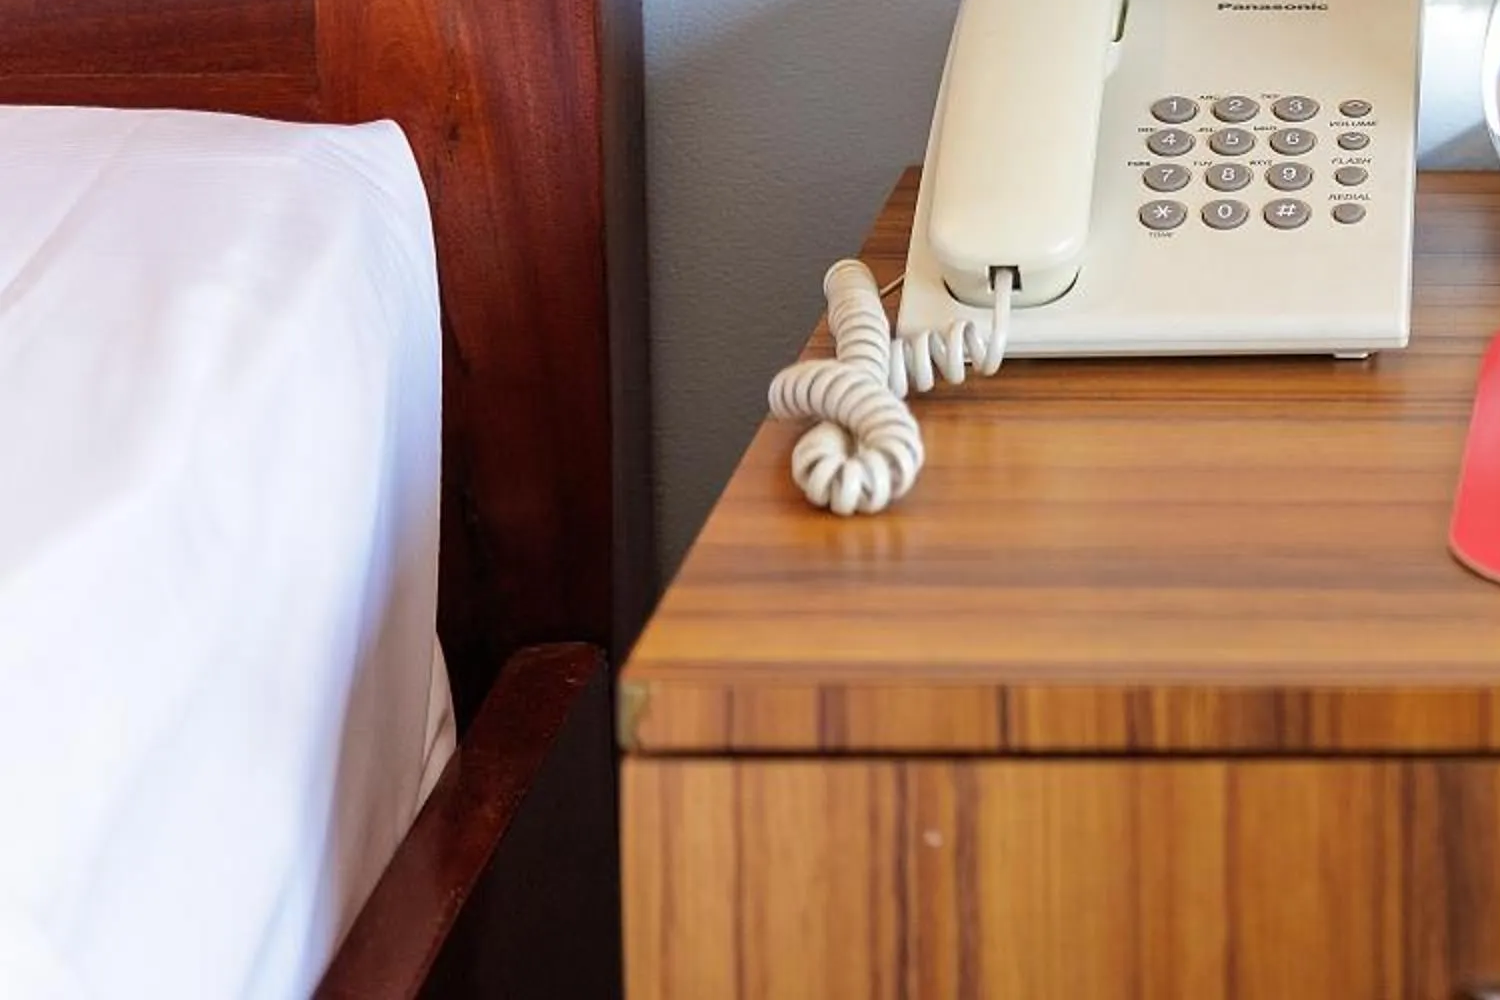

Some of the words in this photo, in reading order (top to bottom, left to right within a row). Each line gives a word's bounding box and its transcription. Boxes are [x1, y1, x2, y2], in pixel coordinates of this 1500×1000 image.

[1217, 2, 1329, 11] Panasonic
[1169, 100, 1178, 113] 1
[1228, 99, 1244, 112] 2
[1161, 132, 1177, 146] 4
[1225, 132, 1240, 145] 5
[1285, 131, 1300, 145] 6
[1161, 168, 1175, 183] 7
[1220, 166, 1236, 181] 8
[1282, 166, 1297, 181] 9
